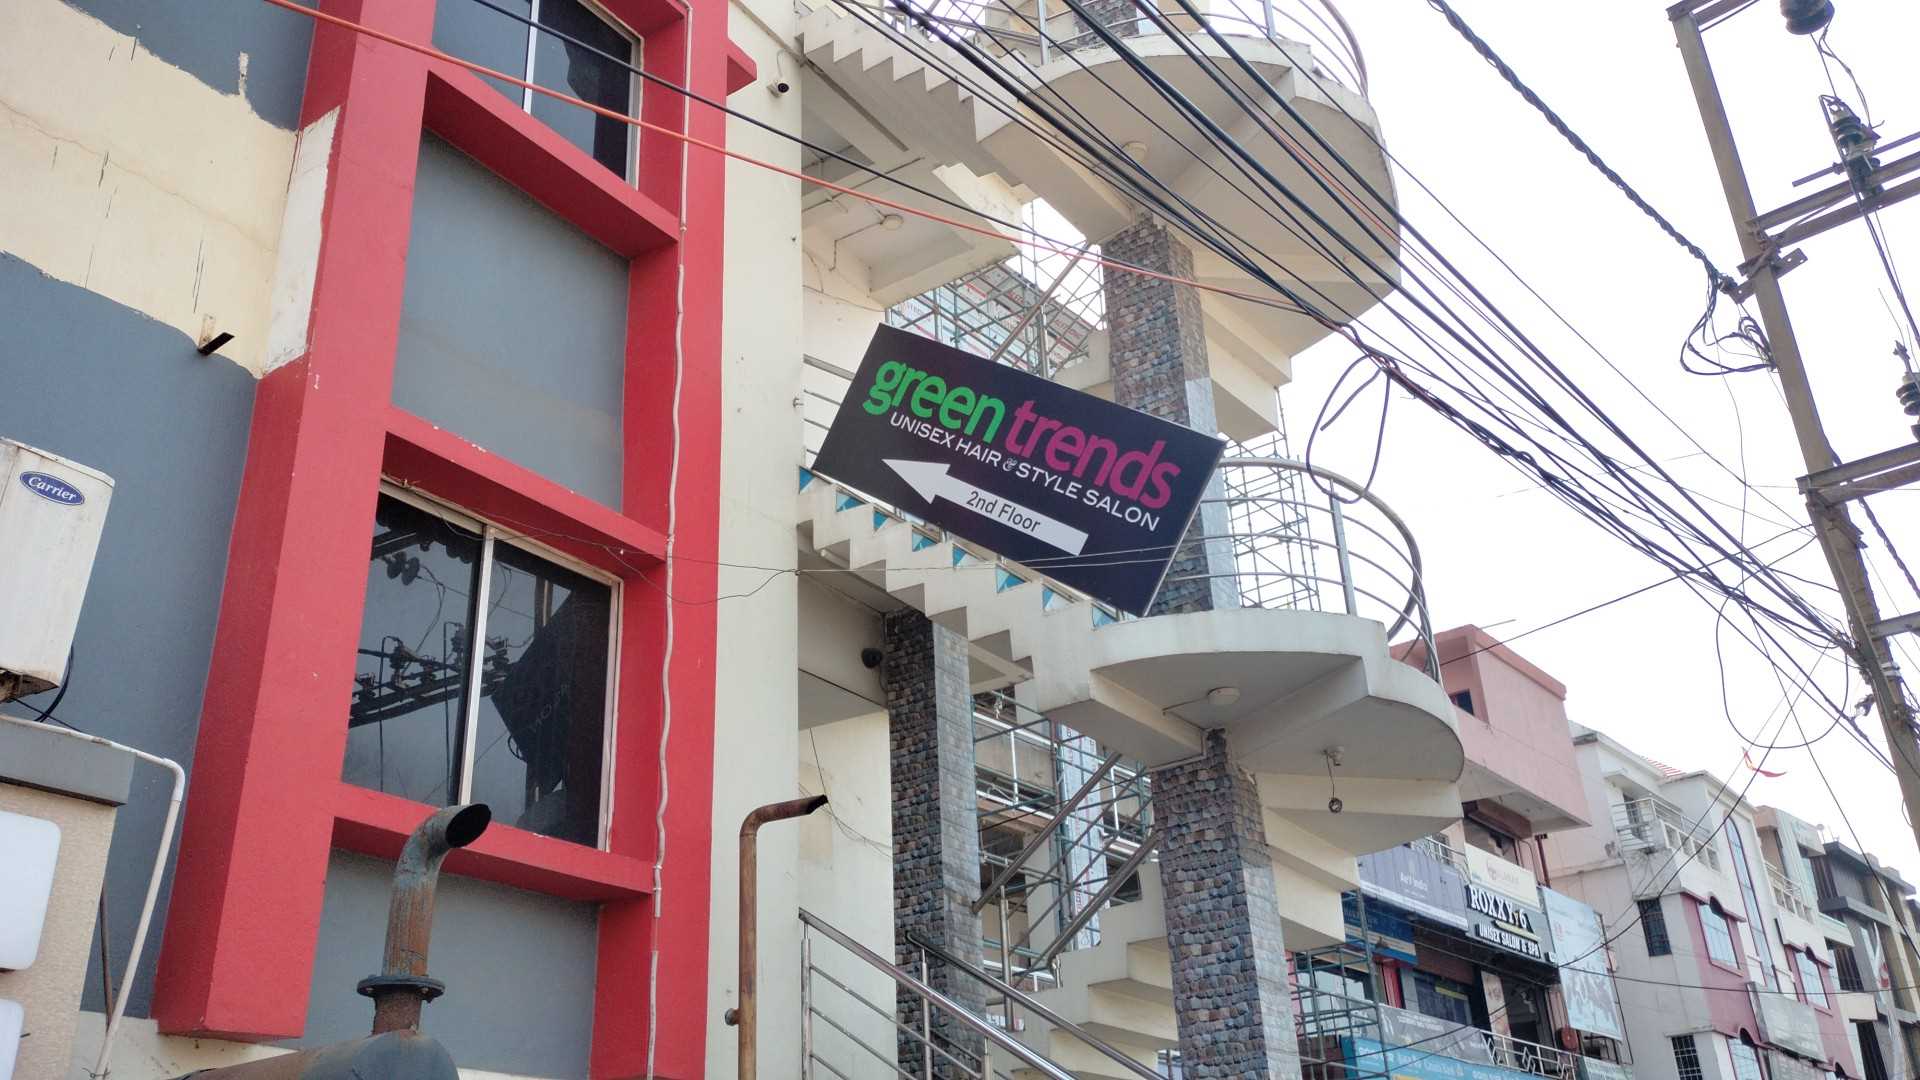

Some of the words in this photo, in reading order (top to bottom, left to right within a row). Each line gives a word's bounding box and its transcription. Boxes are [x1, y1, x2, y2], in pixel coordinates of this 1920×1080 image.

[862, 360, 1005, 446] green
[1004, 400, 1181, 509] trends
[890, 412, 956, 449] UNISEX
[956, 438, 1001, 468] HAIR
[1016, 463, 1082, 499] STYLE
[1083, 488, 1160, 532] SALON
[28, 476, 77, 502] Carrier
[966, 490, 999, 519] 2nd
[998, 499, 1041, 533] Floor
